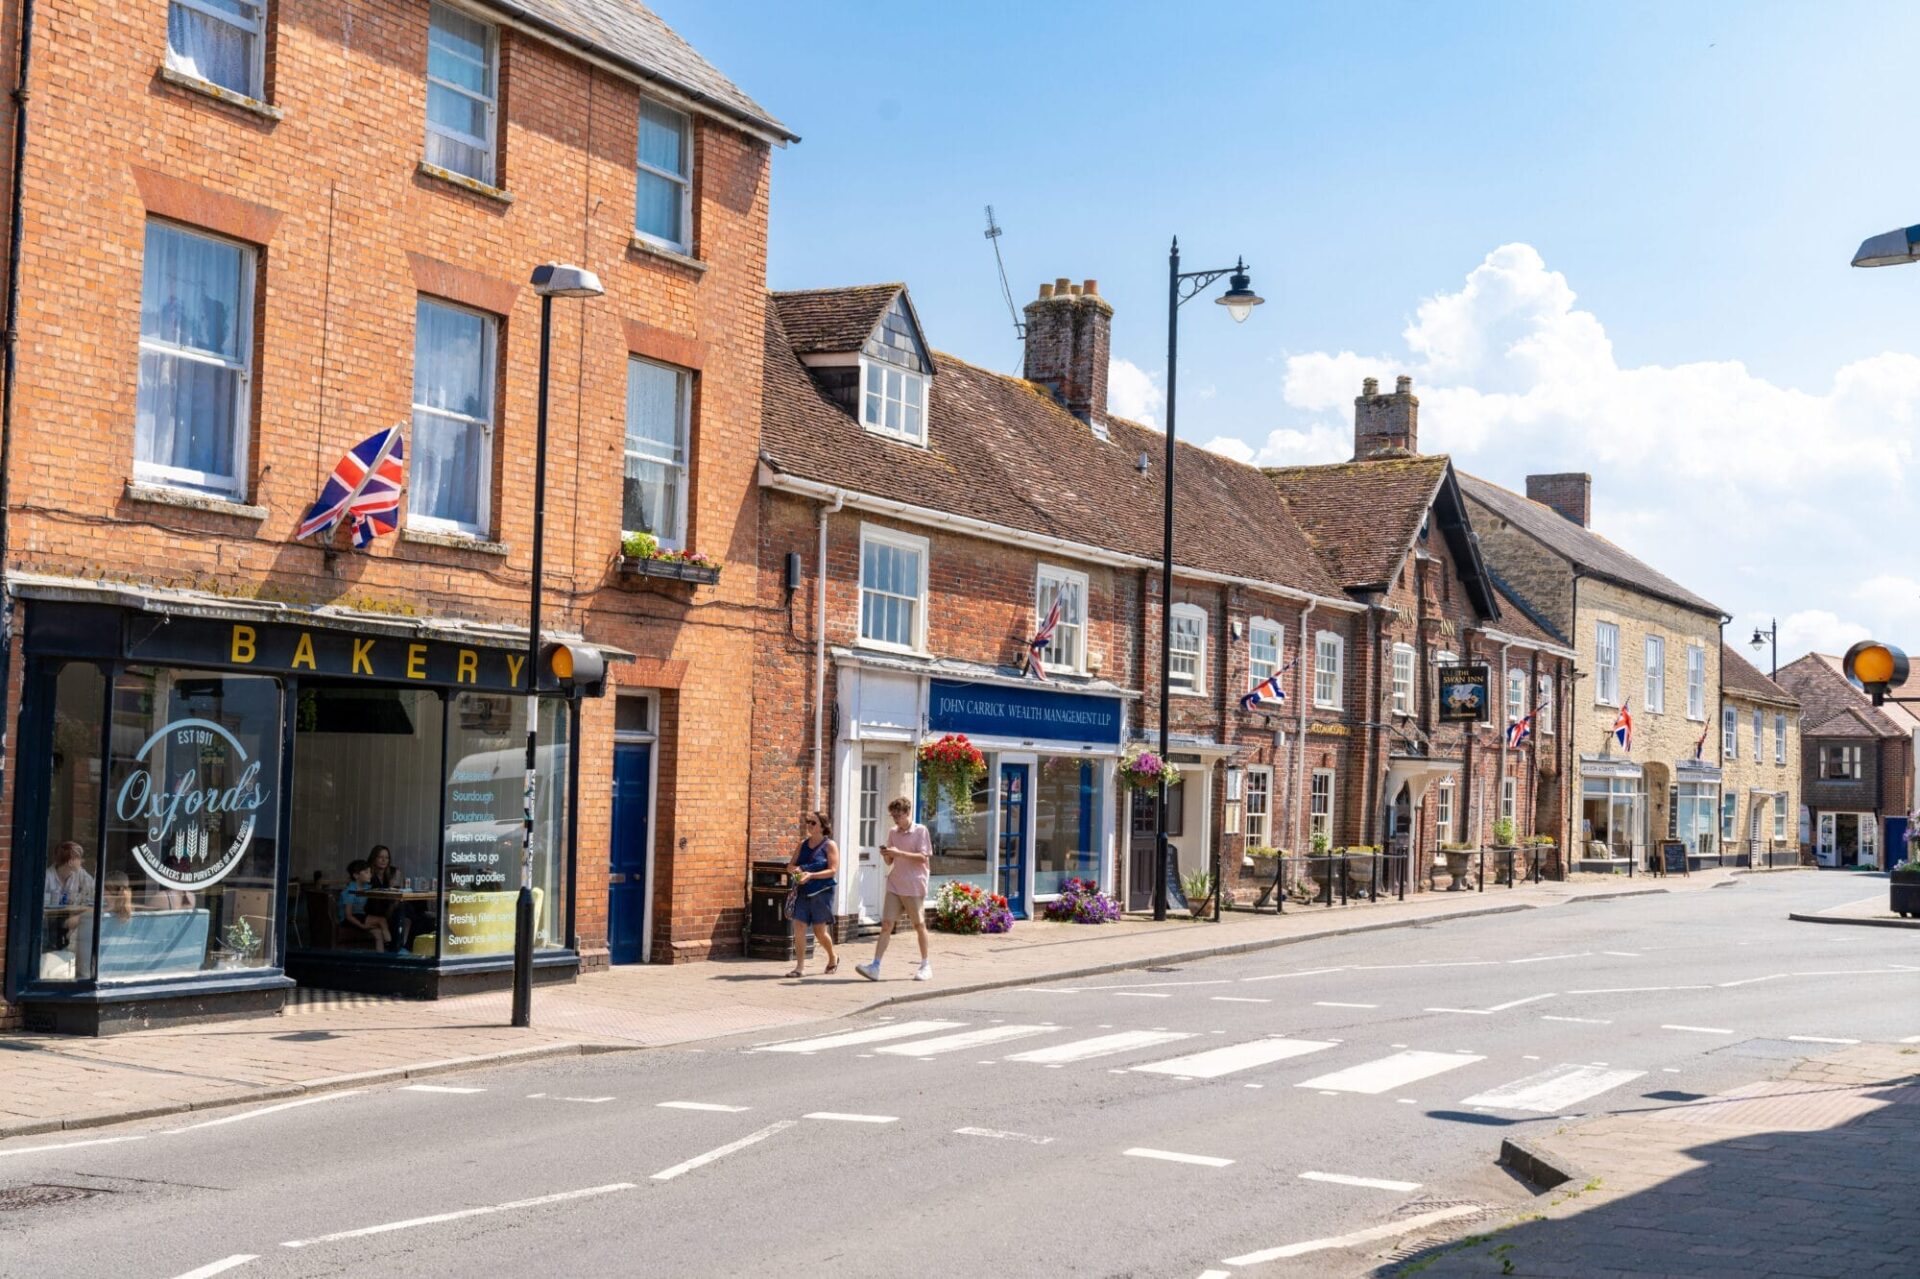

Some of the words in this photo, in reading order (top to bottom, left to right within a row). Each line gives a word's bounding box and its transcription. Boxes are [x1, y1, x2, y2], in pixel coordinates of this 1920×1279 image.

[231, 625, 525, 688] BAKERY
[939, 697, 965, 716] JOHN
[966, 700, 1005, 717] CARRICK
[1008, 704, 1042, 720] WEALTH
[1043, 708, 1097, 726] MANAGEMENT
[1098, 712, 1111, 726] LLP
[178, 730, 195, 744] EST
[196, 730, 213, 746] 1911
[116, 760, 271, 842] Oxford's
[452, 790, 494, 804] Sourdough
[452, 811, 495, 823] Doughnuts
[451, 831, 473, 842] Fresh
[140, 844, 160, 869] ARTISAN
[158, 864, 181, 882] BAKERS
[180, 872, 193, 882] AND
[193, 859, 225, 882] PURVEYORS
[223, 852, 233, 864] OF
[228, 840, 241, 856] FINE
[237, 820, 249, 844] FOODS
[451, 852, 476, 863] Salads
[477, 852, 488, 862] to
[488, 854, 499, 865] go
[450, 872, 474, 885] Vegan
[475, 872, 506, 885] goodies
[449, 893, 477, 904] Dorset
[448, 913, 477, 926] Freshly
[448, 934, 485, 946] Savouries
